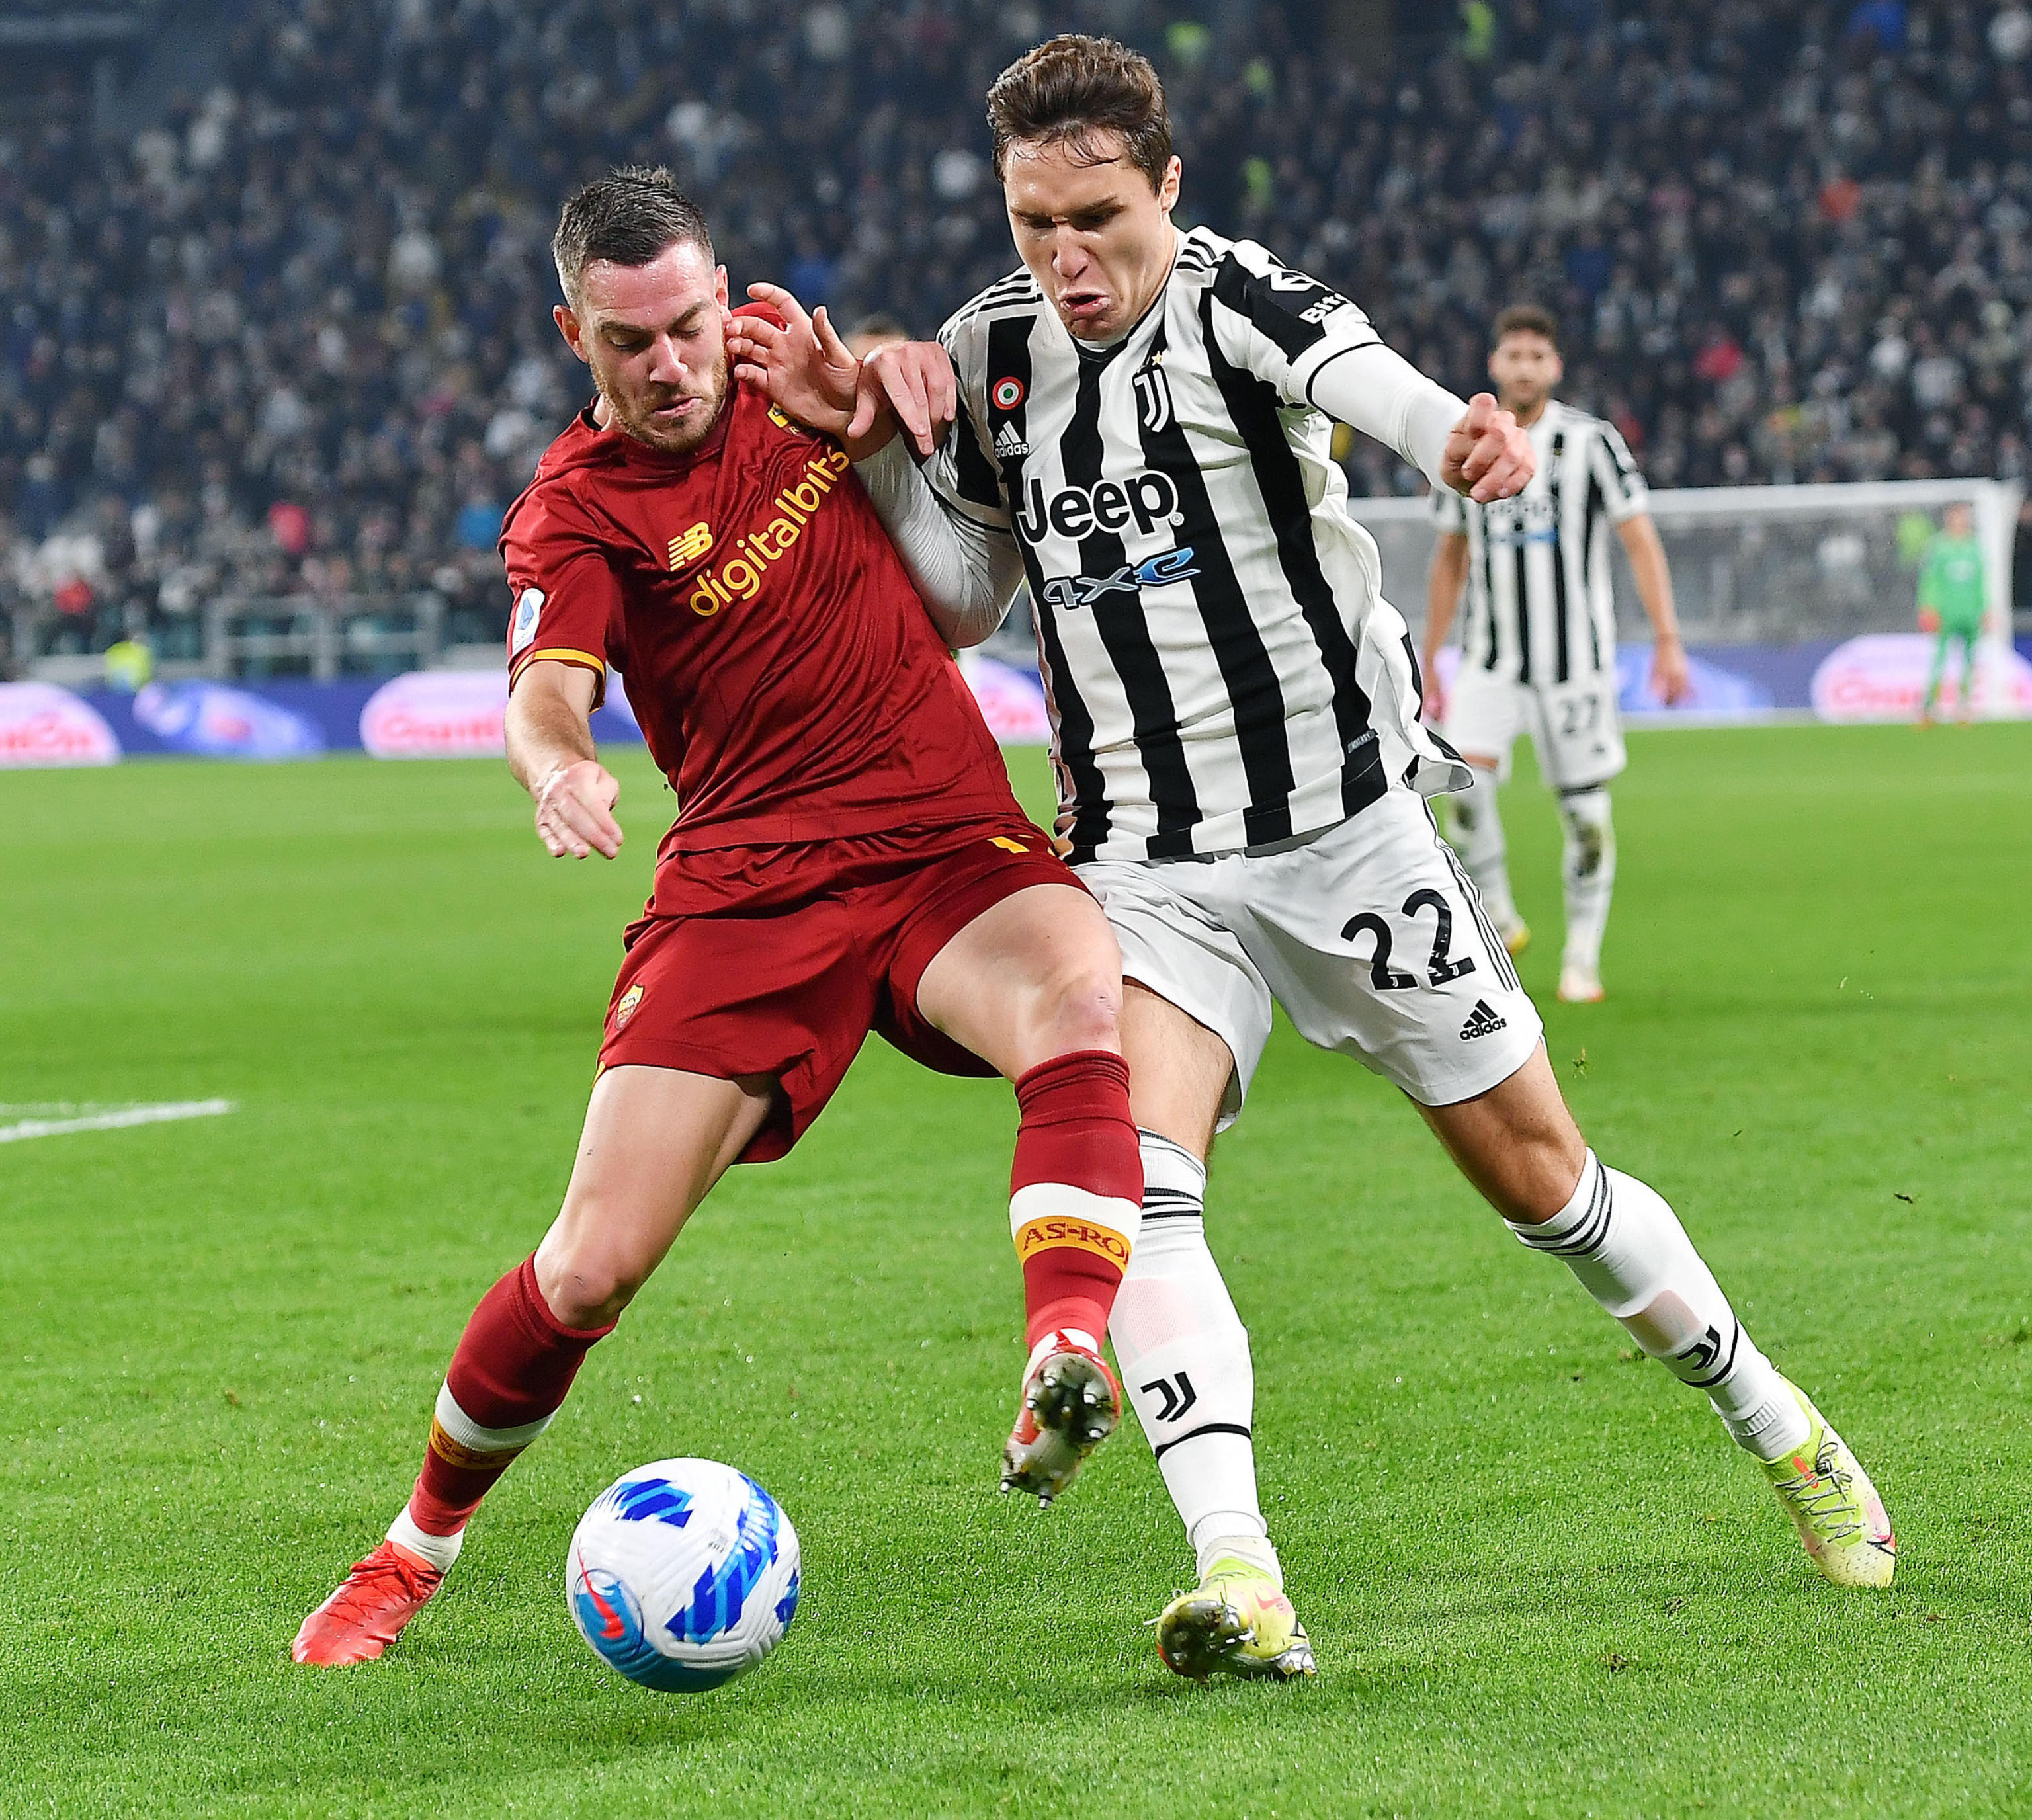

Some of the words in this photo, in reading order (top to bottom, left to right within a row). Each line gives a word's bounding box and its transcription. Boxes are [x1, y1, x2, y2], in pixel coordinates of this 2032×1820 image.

[994, 442, 1029, 458] adidas
[690, 446, 849, 616] digitalbits
[1340, 888, 1476, 991] 22
[1460, 1017, 1507, 1041] adidas
